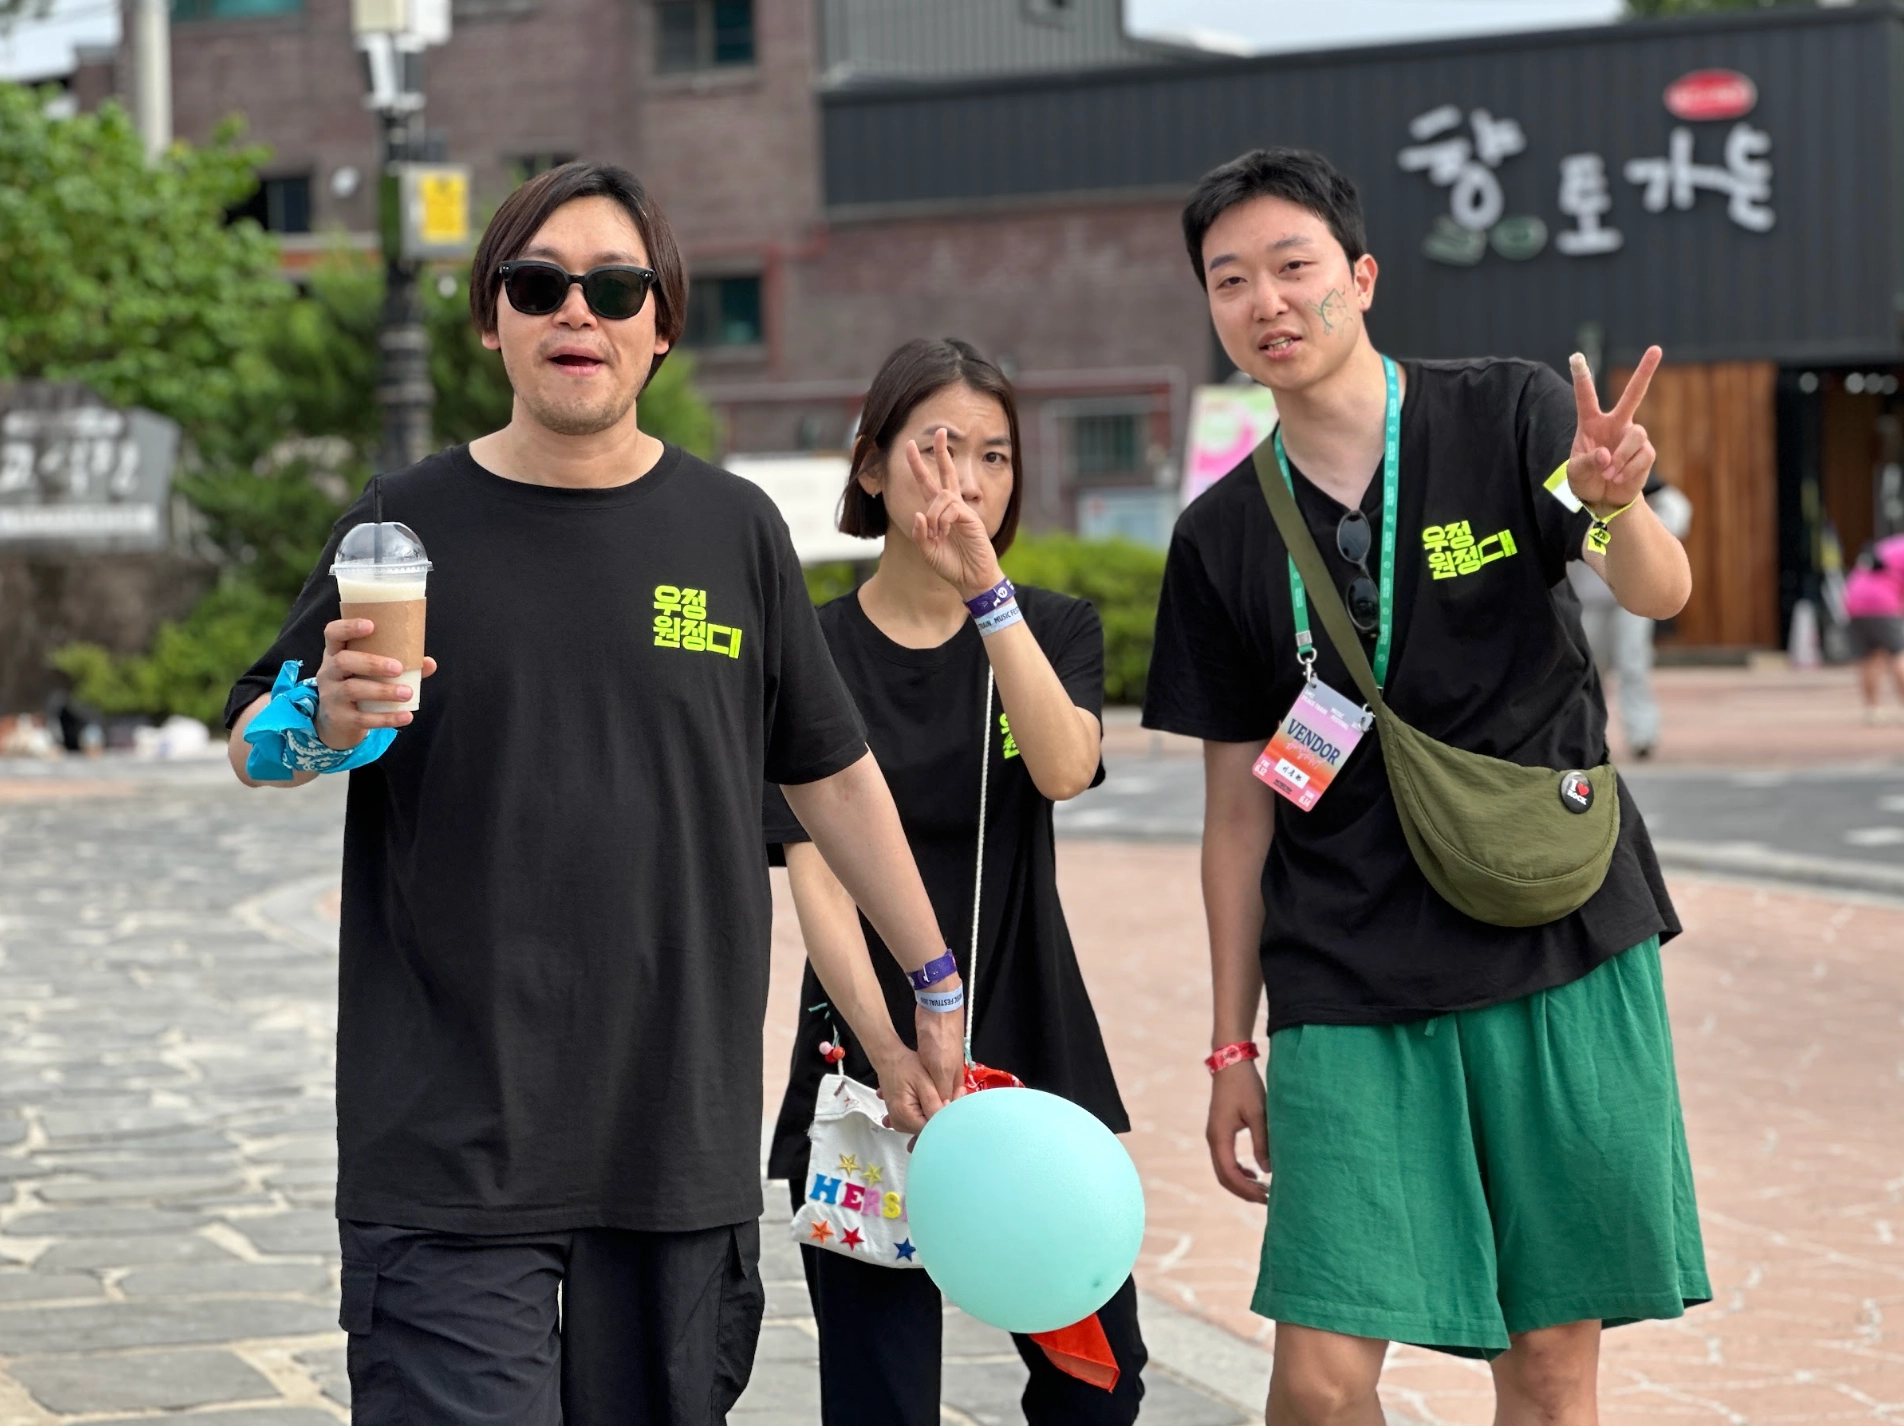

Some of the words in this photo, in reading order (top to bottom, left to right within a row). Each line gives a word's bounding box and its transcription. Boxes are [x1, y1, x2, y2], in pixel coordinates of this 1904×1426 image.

[1423, 520, 1475, 552] 우정
[653, 585, 707, 617] 우정
[994, 611, 1011, 624] MUSIC
[1286, 718, 1341, 766] VENDOR
[929, 998, 953, 1006] FESTIVAL
